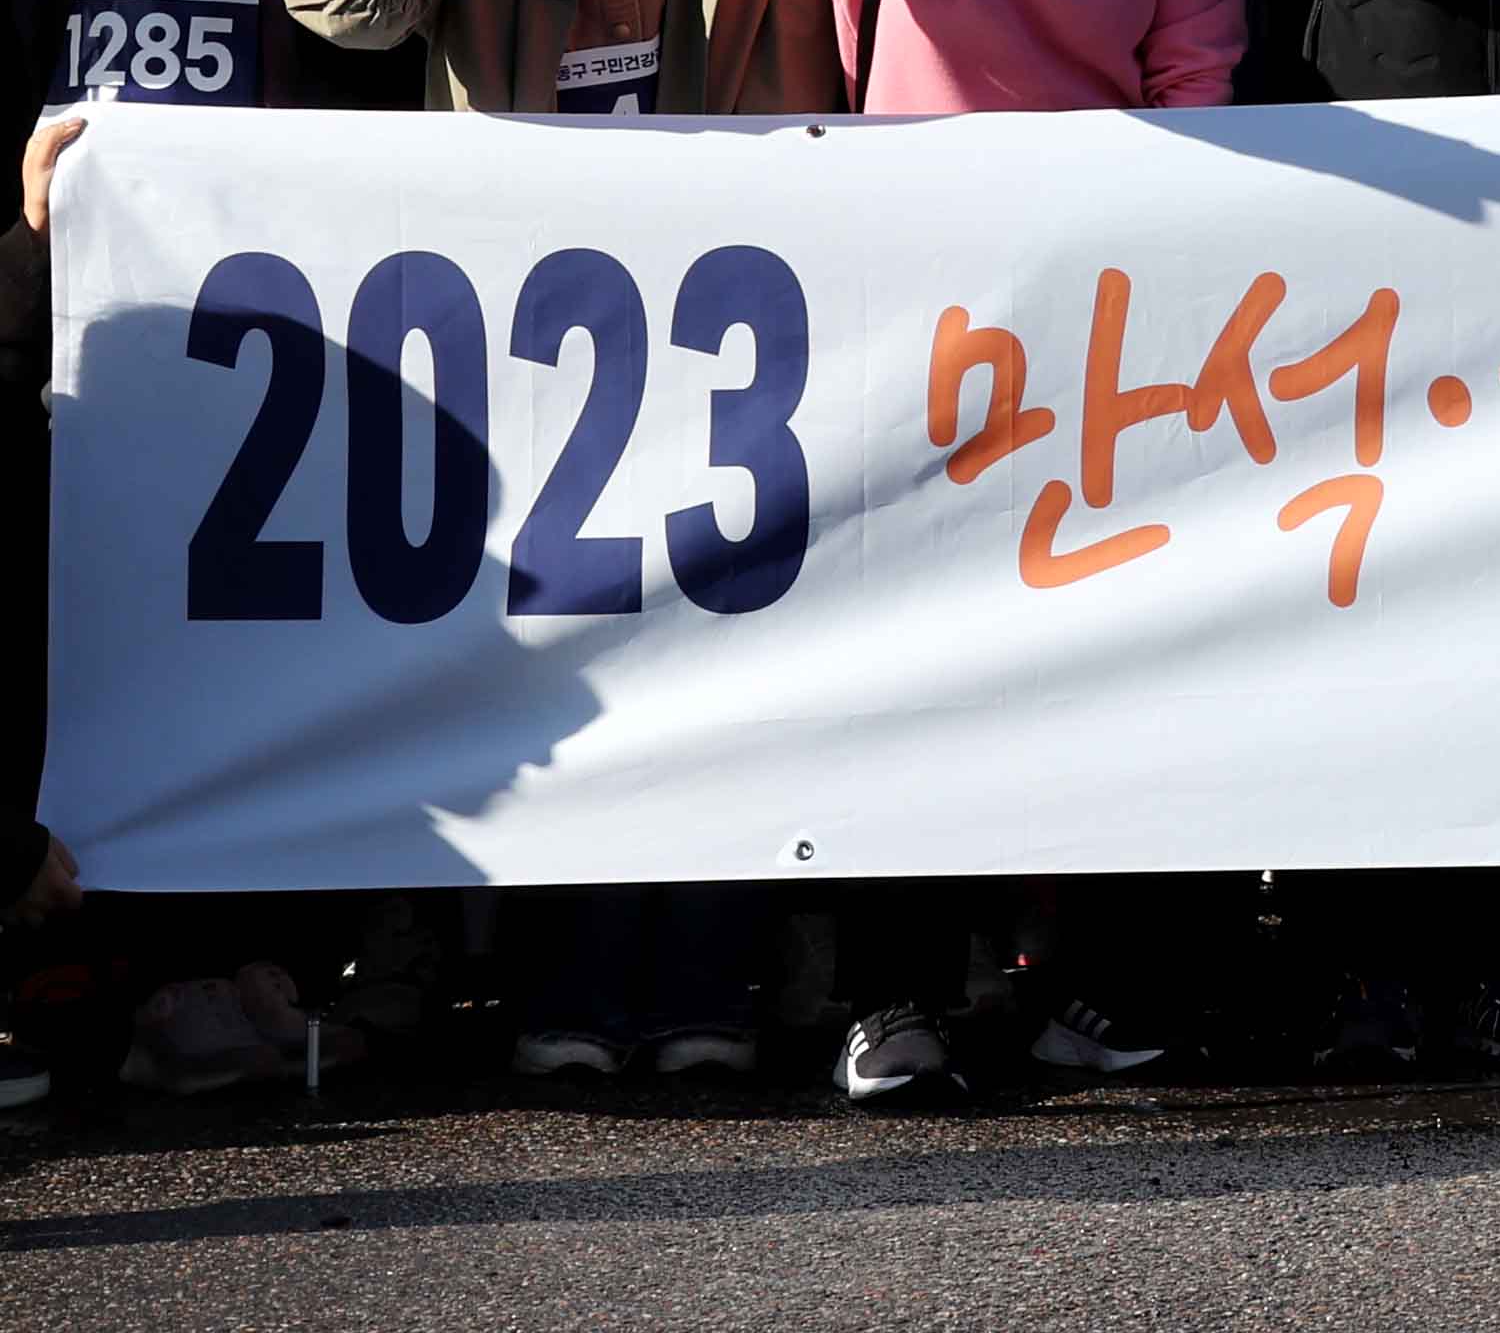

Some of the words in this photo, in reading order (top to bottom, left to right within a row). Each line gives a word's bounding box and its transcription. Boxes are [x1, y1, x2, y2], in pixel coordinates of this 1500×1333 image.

[67, 12, 233, 93] 1285
[557, 60, 587, 82] 동구
[185, 244, 810, 624] 2023
